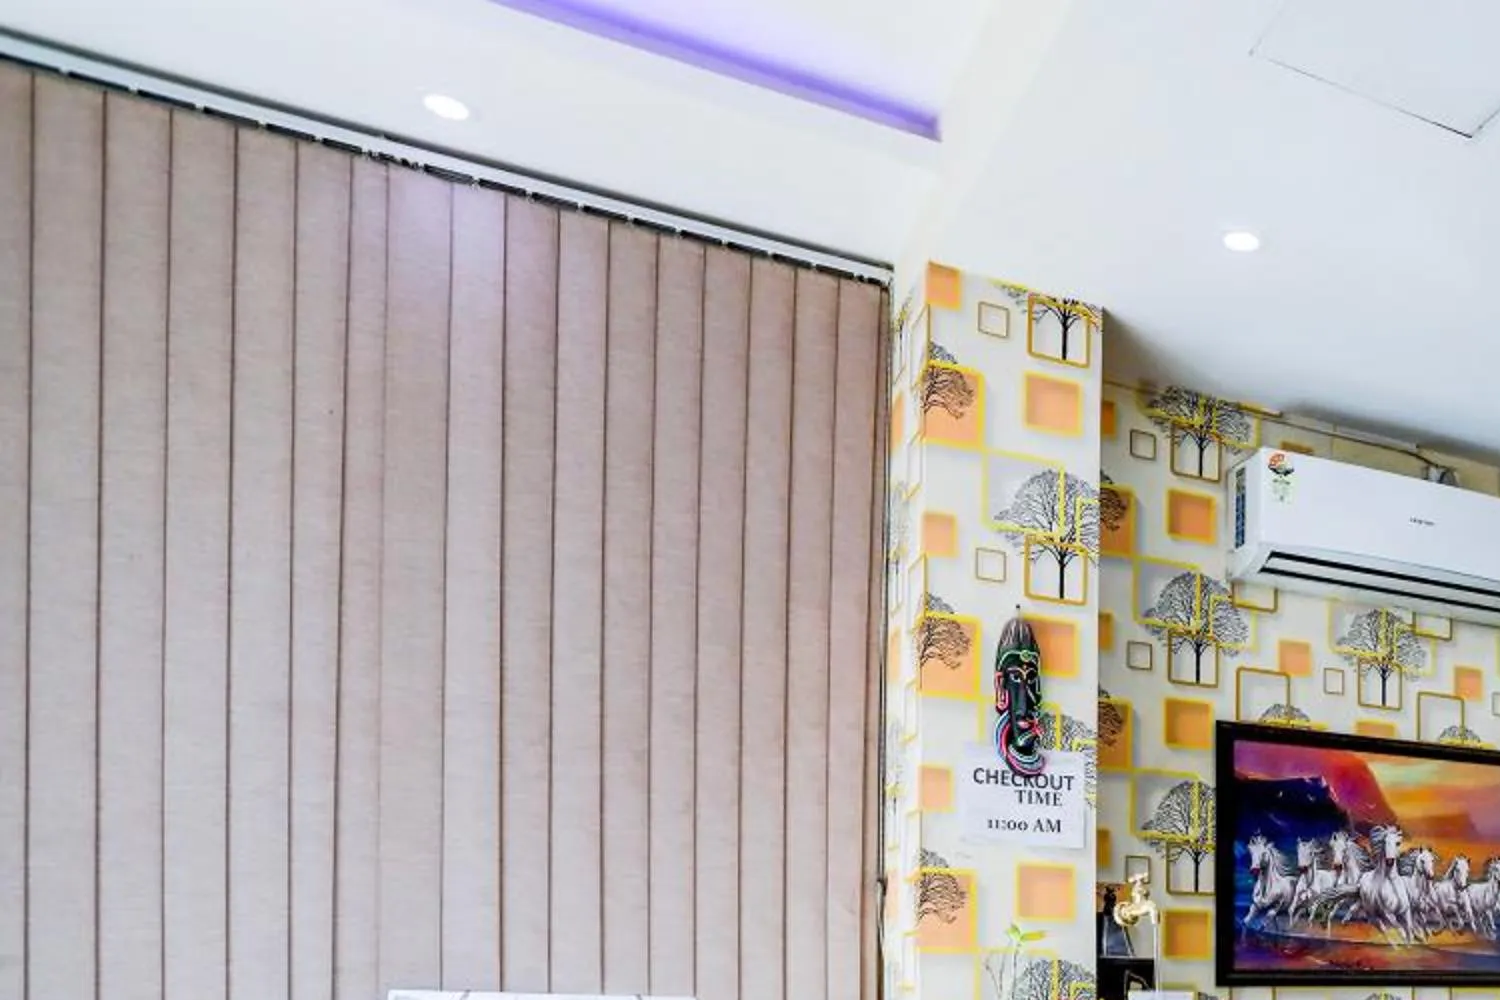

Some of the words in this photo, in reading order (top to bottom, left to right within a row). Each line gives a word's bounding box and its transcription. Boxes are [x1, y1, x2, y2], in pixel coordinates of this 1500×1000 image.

[972, 768, 1073, 790] CHECKOUT
[1014, 790, 1062, 806] TIME
[987, 819, 1027, 830] 11:00
[1032, 819, 1060, 832] AM
